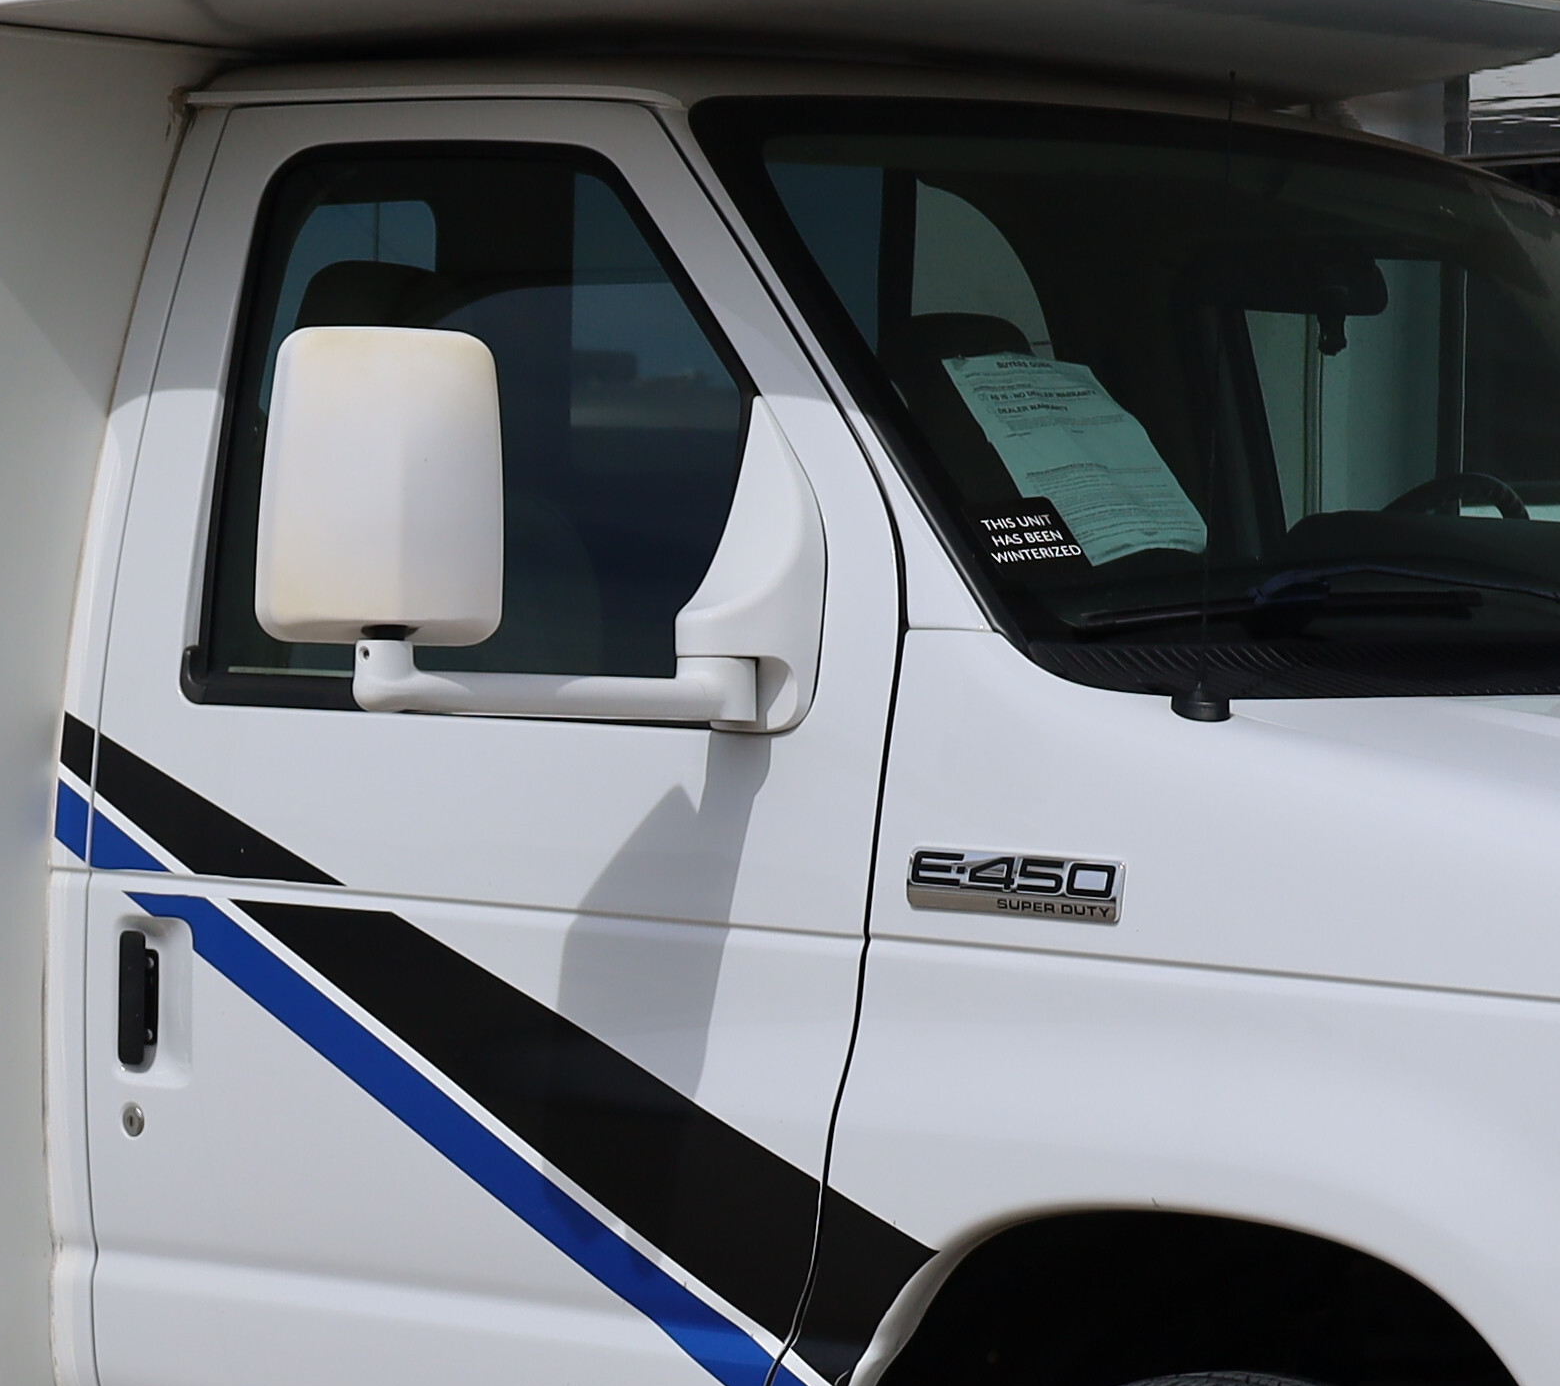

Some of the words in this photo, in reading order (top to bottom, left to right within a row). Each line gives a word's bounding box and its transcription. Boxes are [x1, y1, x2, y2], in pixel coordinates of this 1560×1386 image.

[980, 517, 1016, 531] THIS
[1016, 514, 1052, 527] UNIT
[991, 533, 1023, 547] HAS
[1023, 530, 1064, 544] BEEN
[990, 544, 1082, 564] WINTERIZED
[996, 898, 1055, 914] SUPER
[1061, 903, 1111, 918] DUTY
